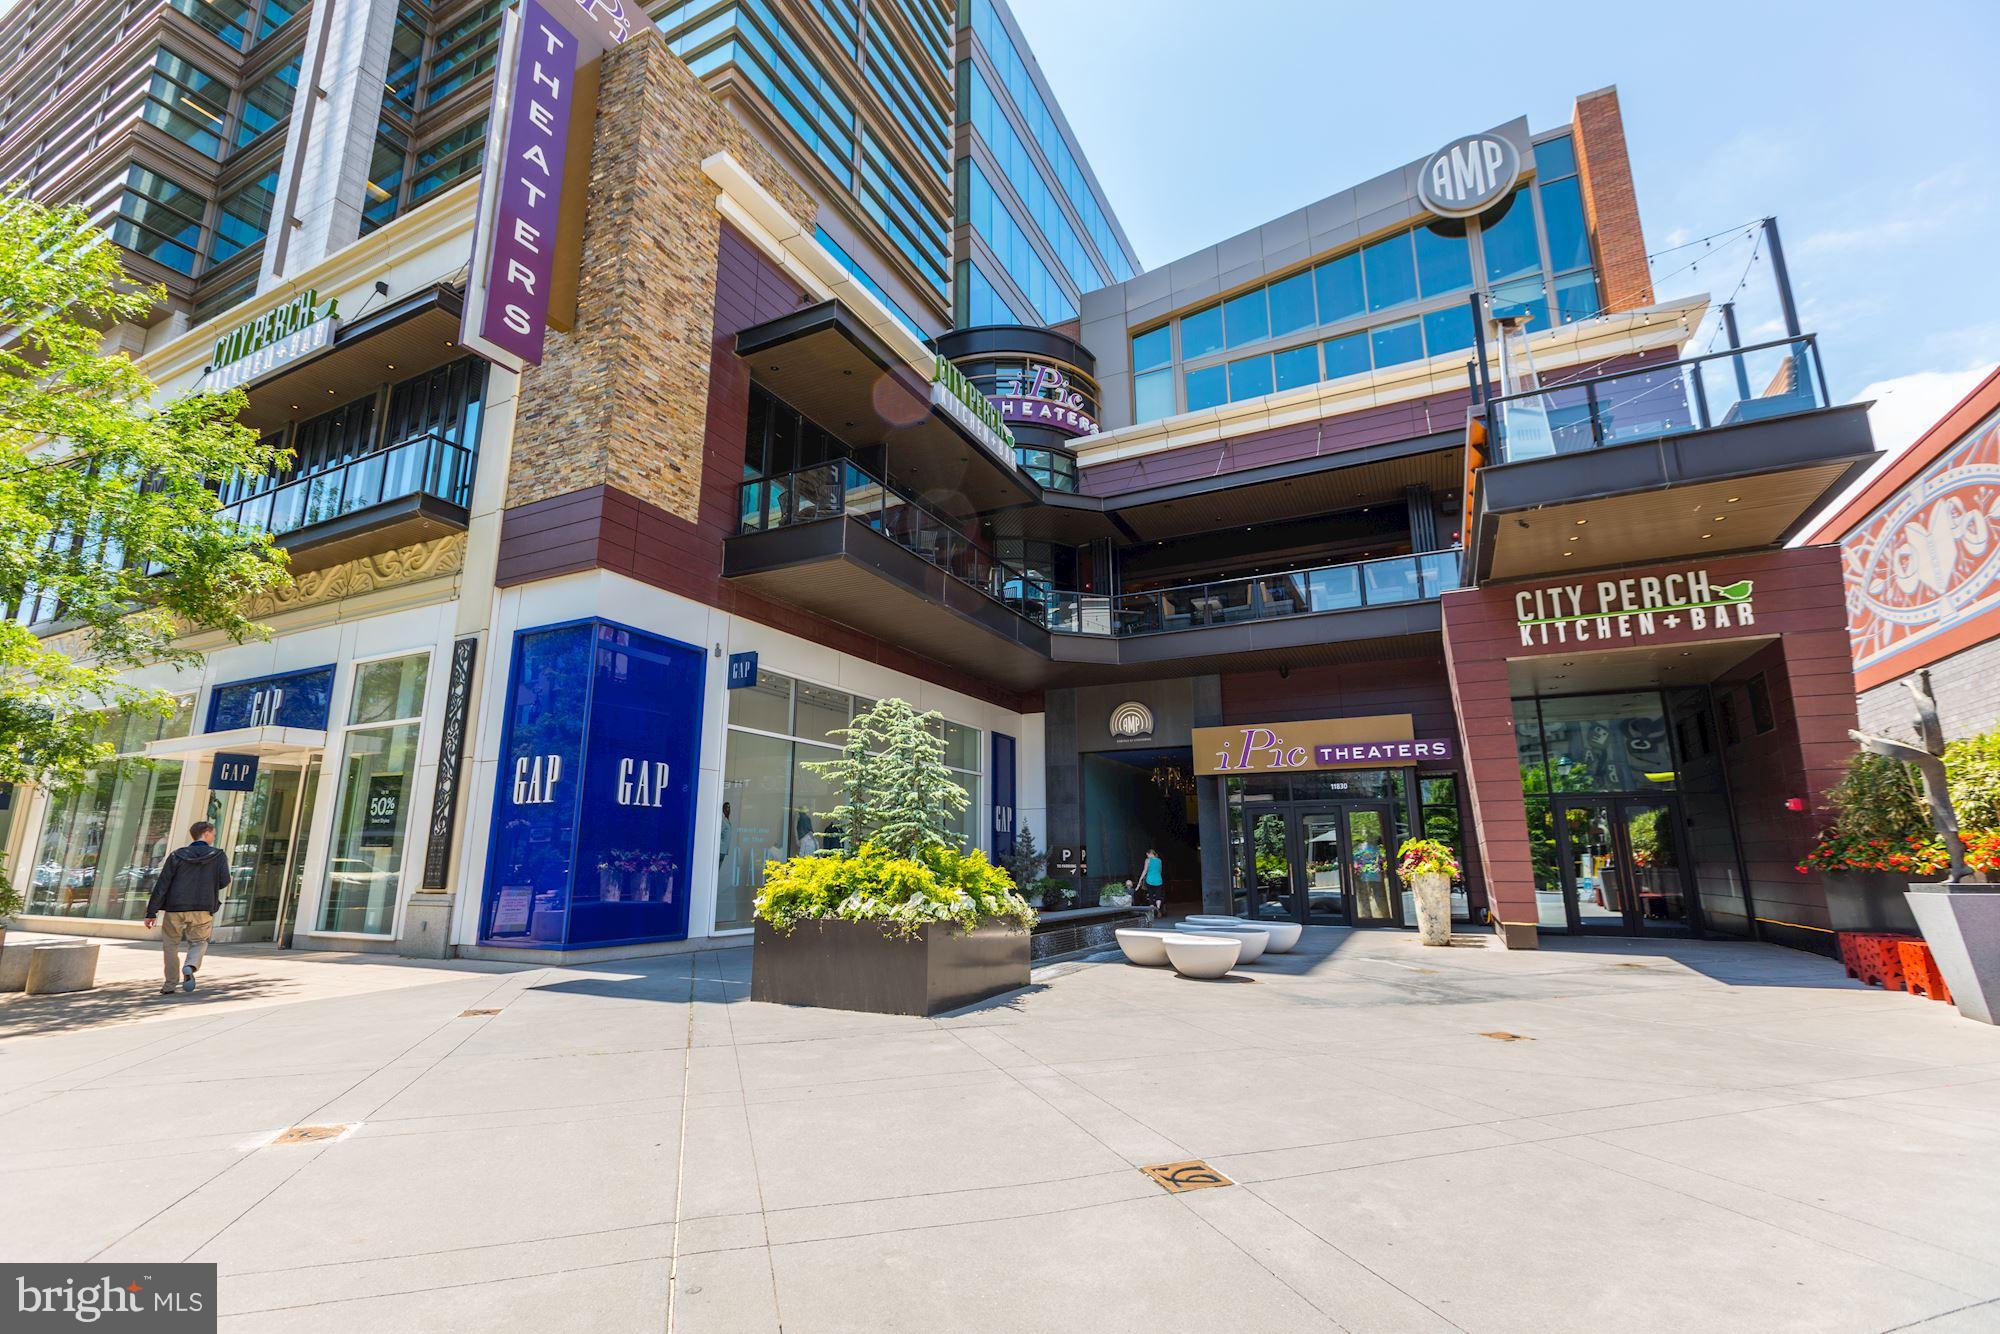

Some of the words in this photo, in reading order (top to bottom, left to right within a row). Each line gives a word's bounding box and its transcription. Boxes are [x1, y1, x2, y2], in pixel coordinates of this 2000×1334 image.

[502, 24, 564, 335] THEATERS
[1432, 140, 1503, 201] AMP
[211, 321, 254, 372] CITY
[252, 288, 317, 353] PERCH
[936, 353, 968, 403] CITY
[966, 380, 1005, 440] PERCH
[1006, 364, 1085, 411] iPic
[941, 384, 989, 444] KITCHEN
[1001, 400, 1099, 435] HEATERS
[1515, 583, 1583, 622] CITY
[1597, 570, 1712, 614] PERCH
[1519, 613, 1656, 647] KITCHEN
[1690, 603, 1755, 631] BAR
[733, 661, 751, 680] GAP
[251, 688, 283, 726] GAP
[1122, 715, 1140, 733] AMP
[1213, 728, 1308, 771] iPic
[1320, 742, 1447, 761] THEATERS
[220, 762, 250, 782] GAP
[513, 754, 562, 805] GAP
[617, 757, 670, 807] GAP
[1330, 782, 1348, 790] 11830
[370, 797, 395, 816] 50%
[995, 805, 1012, 832] GAP
[1062, 849, 1071, 861] P
